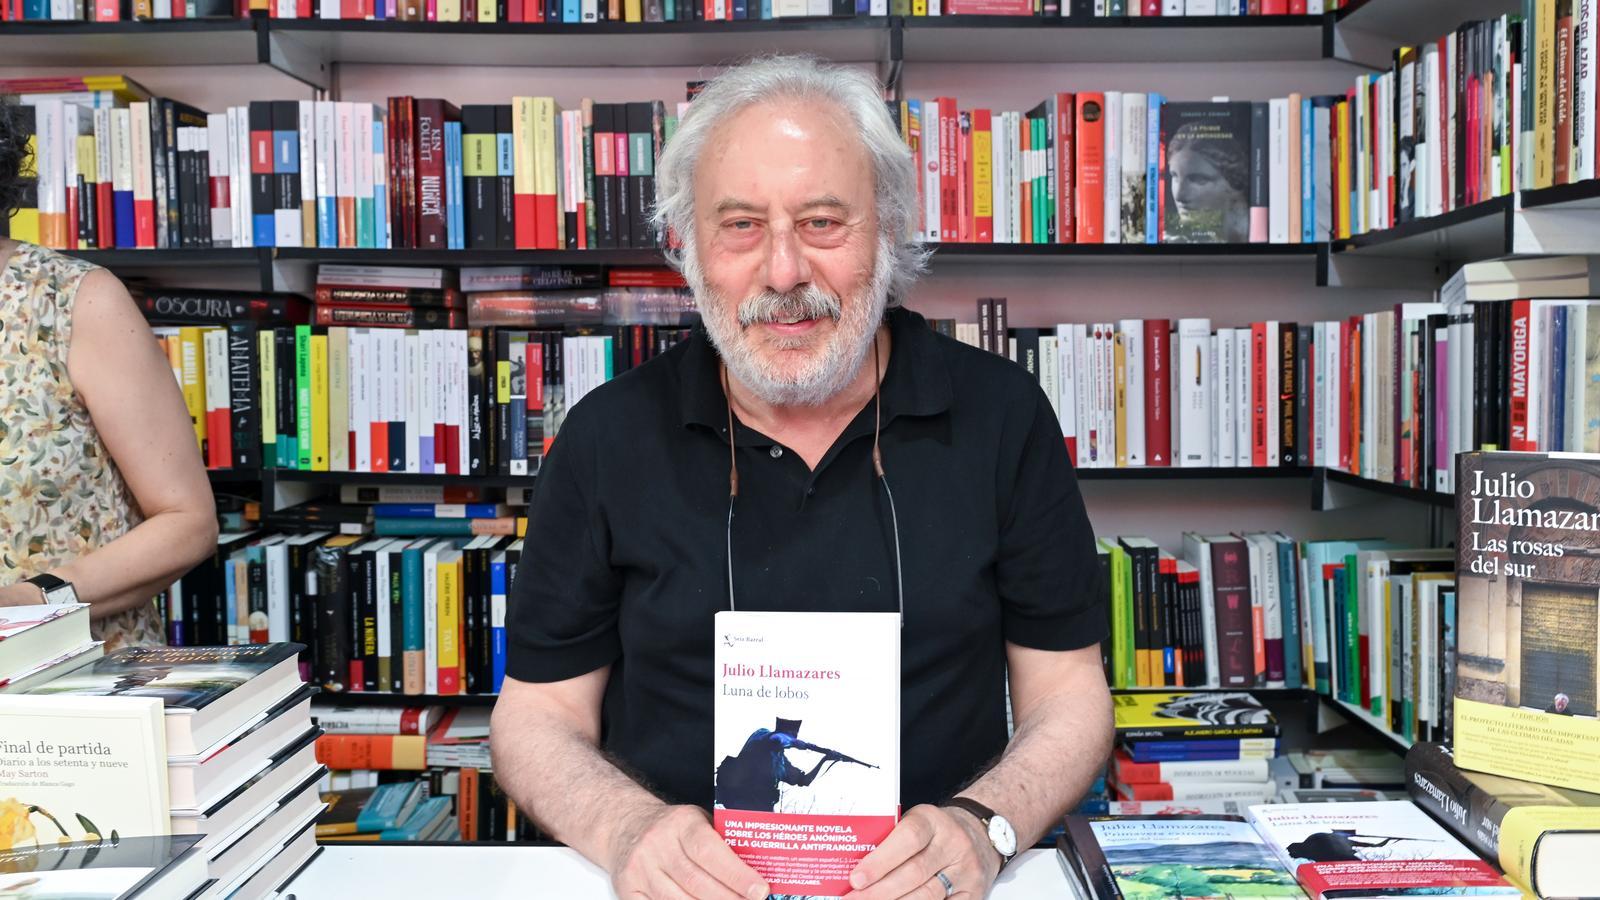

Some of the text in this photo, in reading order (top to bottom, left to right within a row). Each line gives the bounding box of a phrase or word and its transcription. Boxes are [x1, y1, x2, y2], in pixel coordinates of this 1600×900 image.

[420, 117, 432, 162] FOLLETT
[432, 129, 441, 151] KEN
[422, 176, 440, 216] NUNCA
[156, 297, 233, 317] OSCURA
[1513, 317, 1527, 397] MAYORGA
[231, 336, 252, 413] ANATEMA
[1284, 332, 1294, 447] NUNCA TE PARES PHIL KNIGHT
[1470, 470, 1535, 498] Julio
[1471, 498, 1600, 532] Llamazar
[1471, 532, 1564, 557] Las rosas
[1470, 555, 1536, 578] del sur
[363, 616, 376, 656] LA NIÑERA
[723, 663, 841, 680] Julio Llamazares
[723, 684, 810, 700] Luna de lobos
[1468, 716, 1505, 727] PROYECTO
[1505, 722, 1541, 732] LITERARIO
[36, 741, 54, 754] de
[58, 742, 112, 758] partida
[18, 770, 49, 778] Sarton
[37, 758, 51, 767] los
[53, 759, 89, 768] setenta
[91, 761, 96, 769] y
[100, 760, 129, 768] nueve
[1414, 773, 1467, 825] Llamazares Julio
[725, 821, 852, 834] UNA IMPRESIONANTE NOVELA
[725, 830, 857, 843] SOBRE LOS HÉROES ANÓNIMOS
[738, 839, 749, 847] LA
[751, 840, 799, 850] GUERRILLA
[801, 843, 877, 852] ANTIFRANQUISTA
